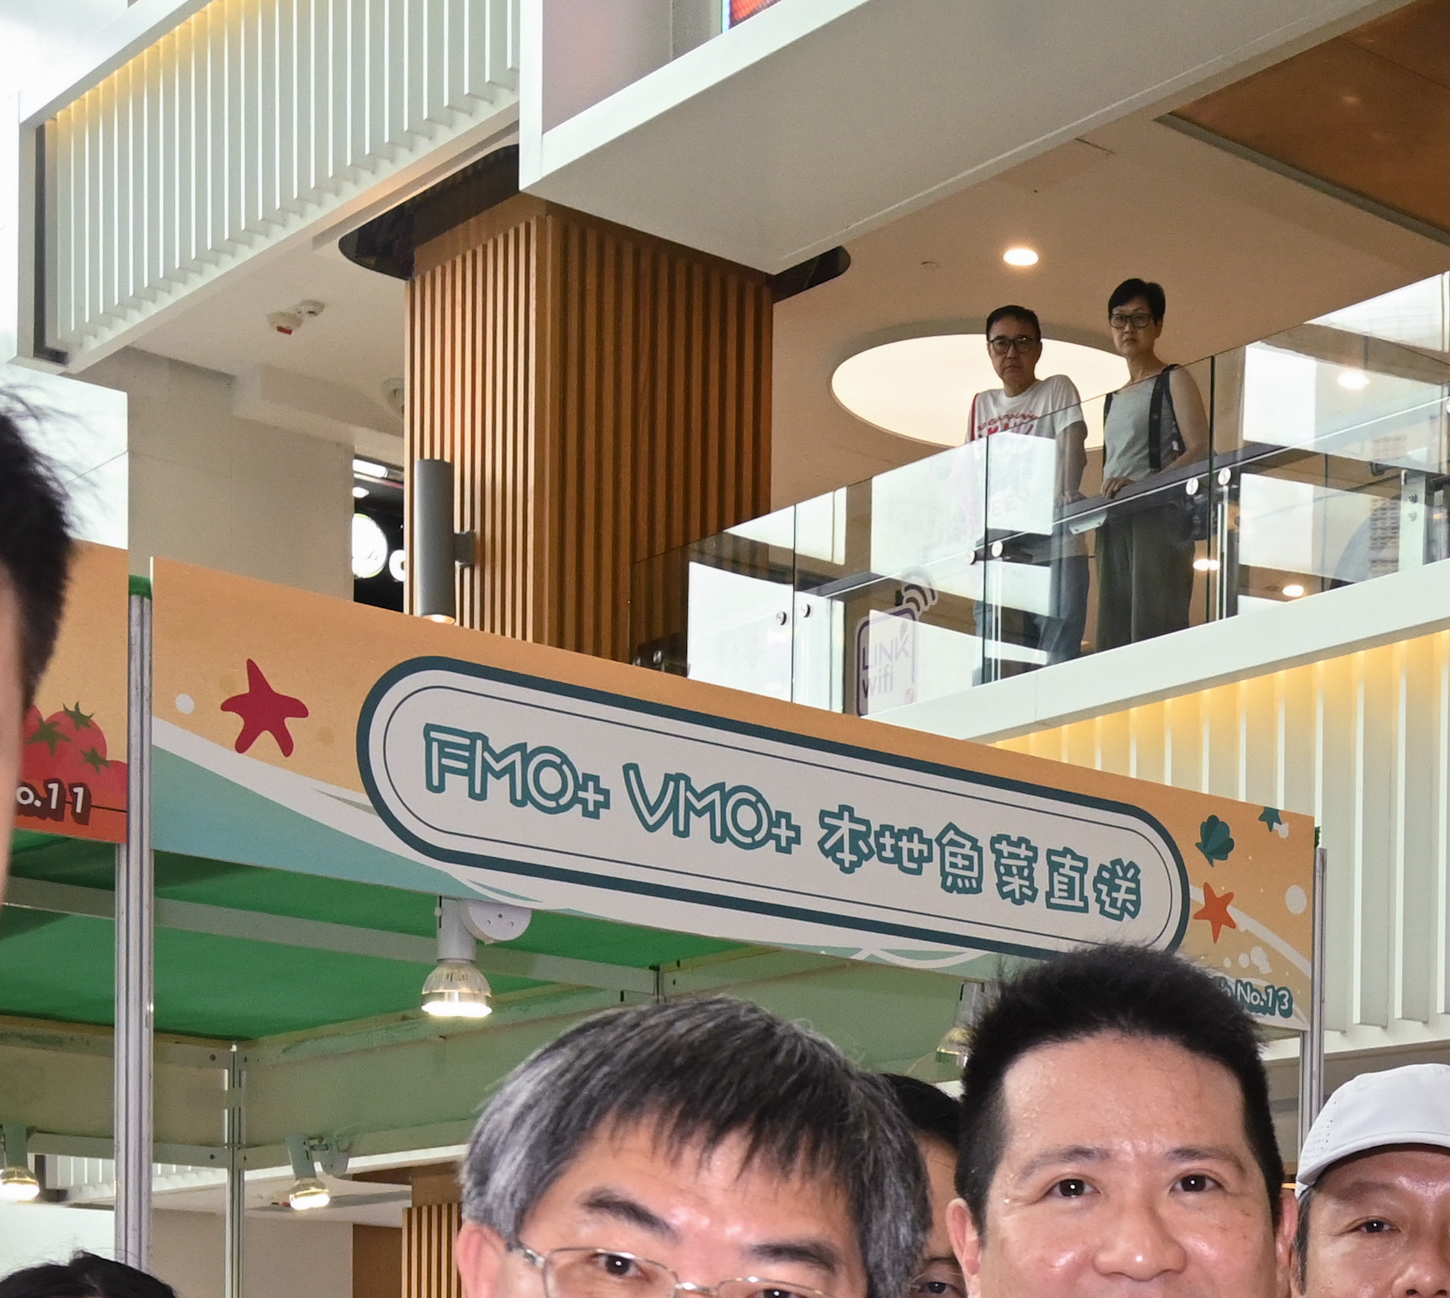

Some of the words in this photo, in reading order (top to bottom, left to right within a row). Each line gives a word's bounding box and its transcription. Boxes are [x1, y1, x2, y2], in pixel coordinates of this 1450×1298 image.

[16, 777, 92, 826] o.11
[423, 723, 611, 818] FMO+
[622, 762, 801, 854] VMO+
[818, 804, 1141, 922] 本地魚菜直送
[1235, 979, 1293, 1018] No.13
